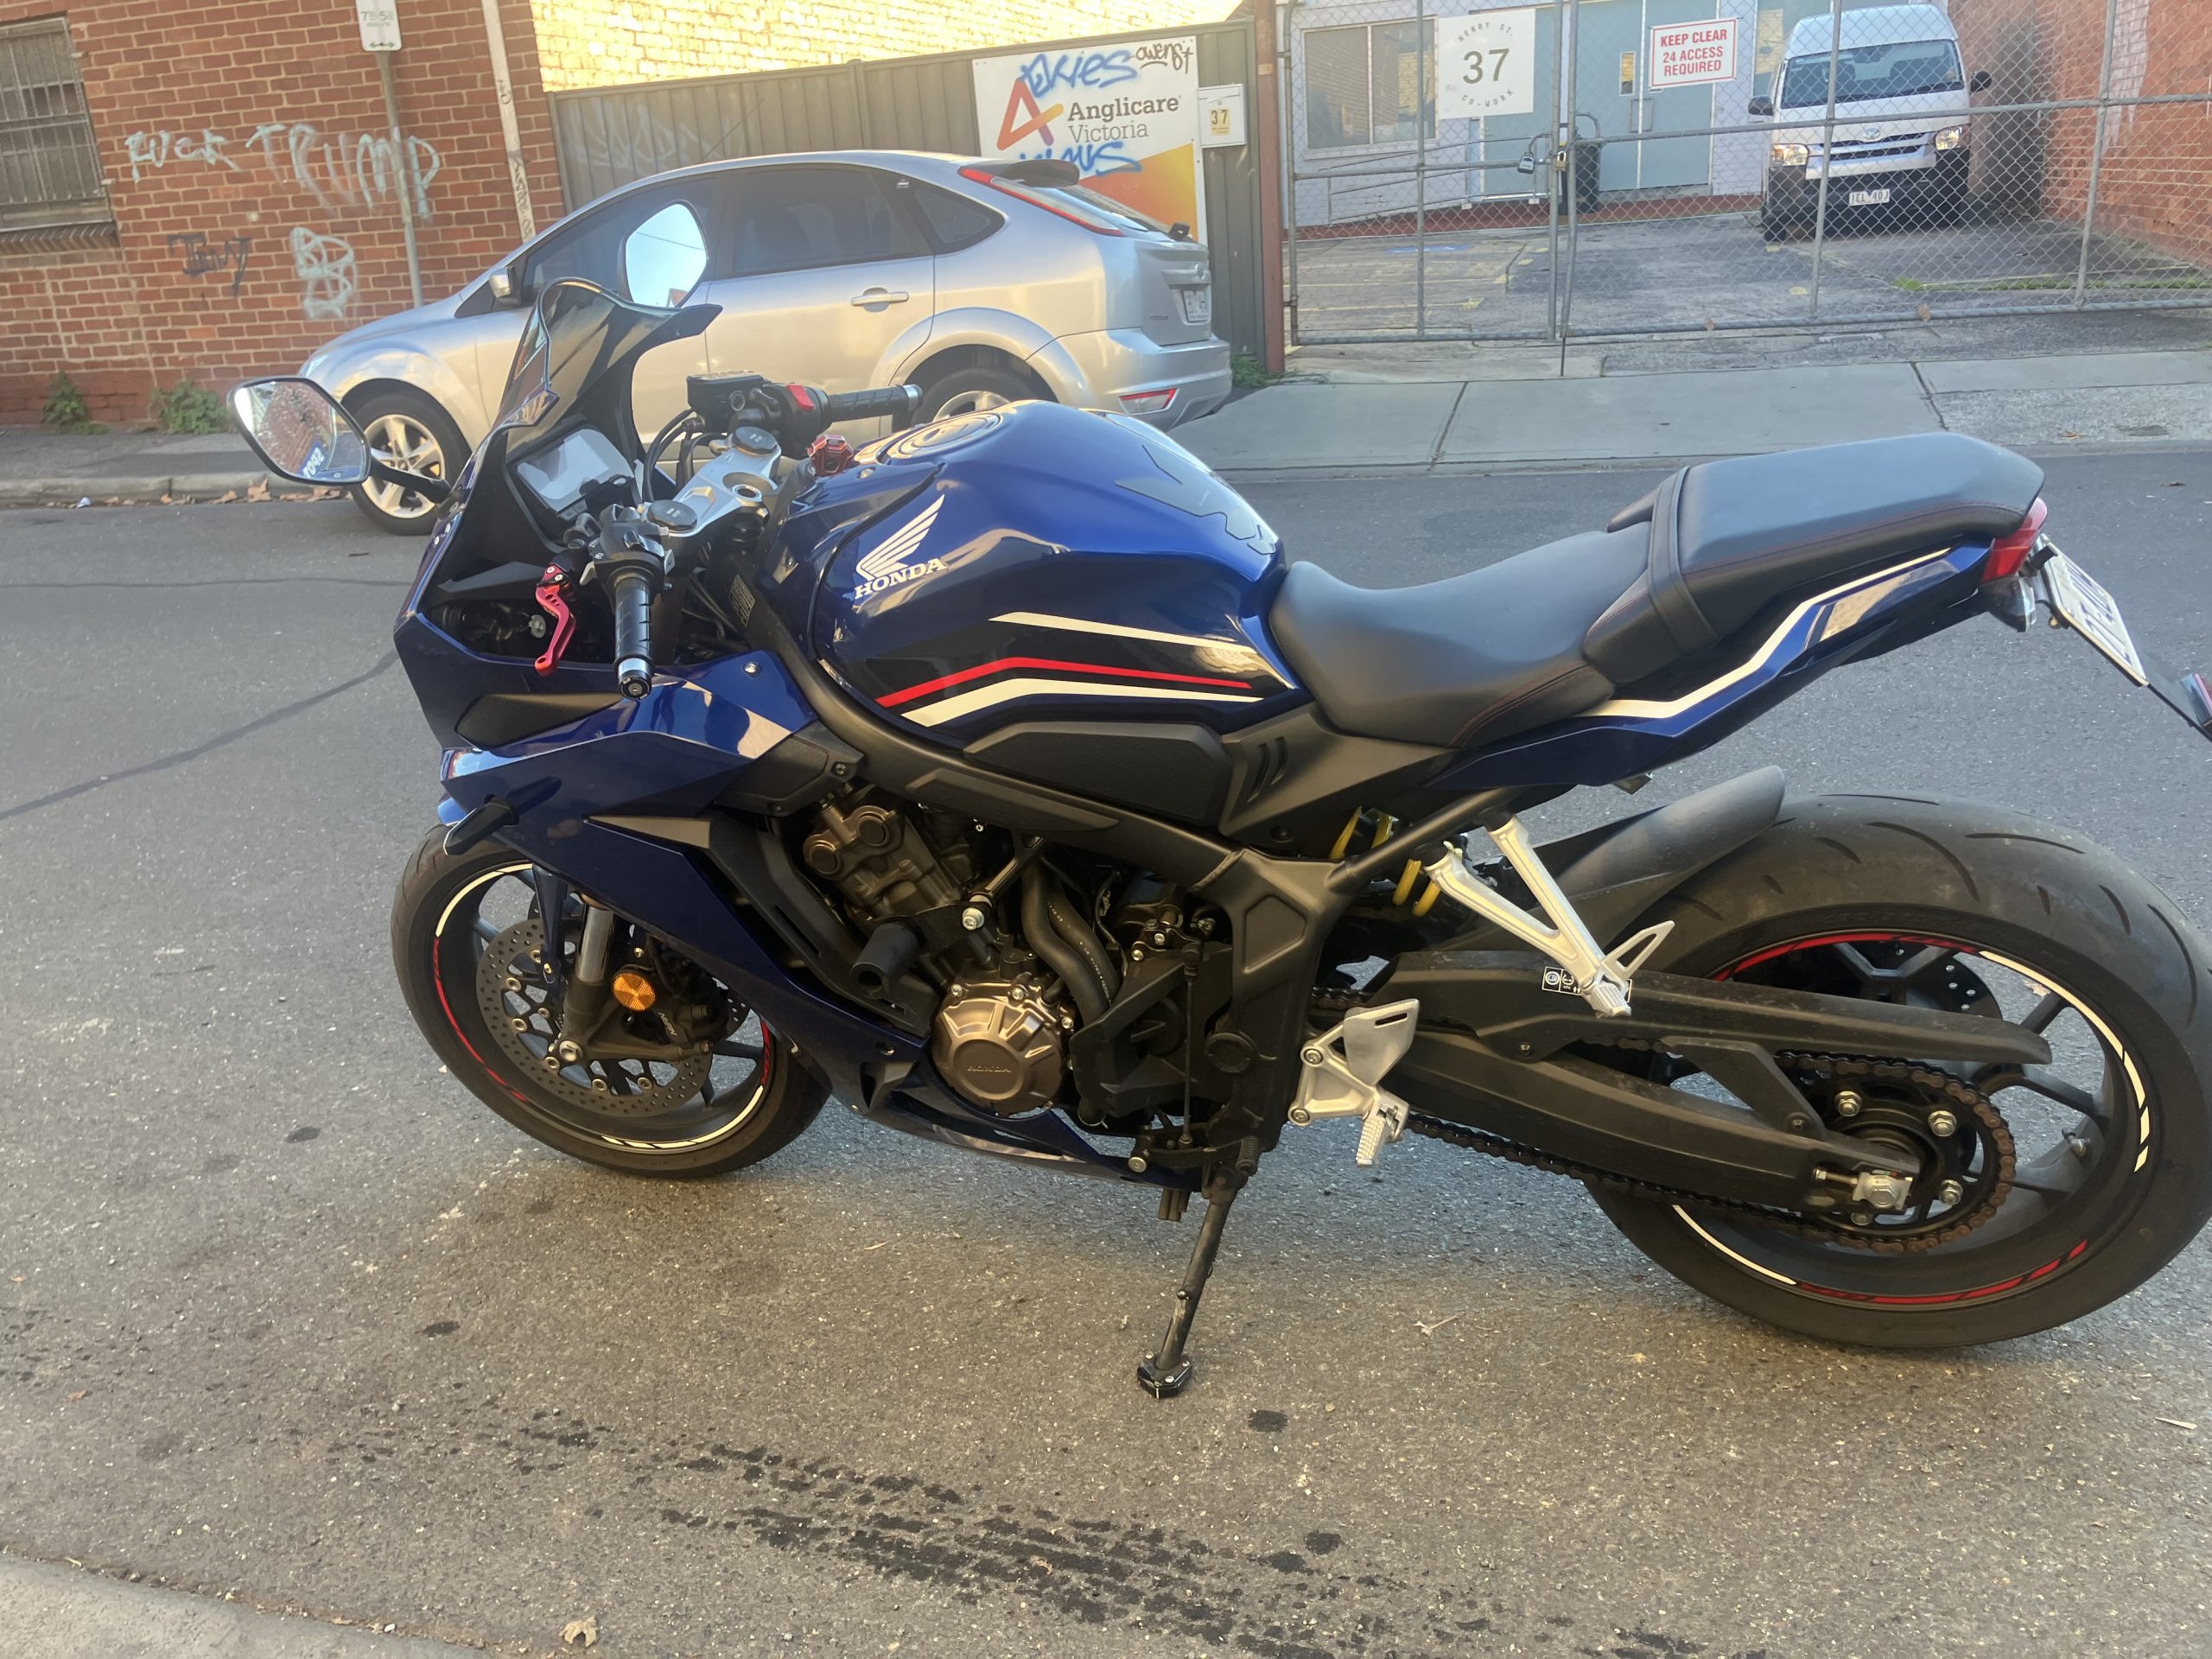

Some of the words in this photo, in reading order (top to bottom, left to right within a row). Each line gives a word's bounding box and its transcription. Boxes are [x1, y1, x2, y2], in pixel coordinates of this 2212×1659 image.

[1458, 22, 1490, 41] HENRY
[1660, 33, 1688, 47] KEEP
[1692, 29, 1727, 43] CLEAR
[1663, 51, 1676, 63] 24
[1680, 46, 1723, 61] ACCESS
[1462, 48, 1510, 84] 37
[1664, 60, 1721, 76] REQUIRED
[1462, 88, 1513, 107] CO-WORK
[1067, 96, 1179, 123] Anglicare
[1211, 109, 1228, 124] 37
[1068, 119, 1149, 143] Victoria
[245, 124, 441, 219] TRUMP
[855, 557, 948, 600] HONDA
[967, 1064, 1012, 1073] HONDA
